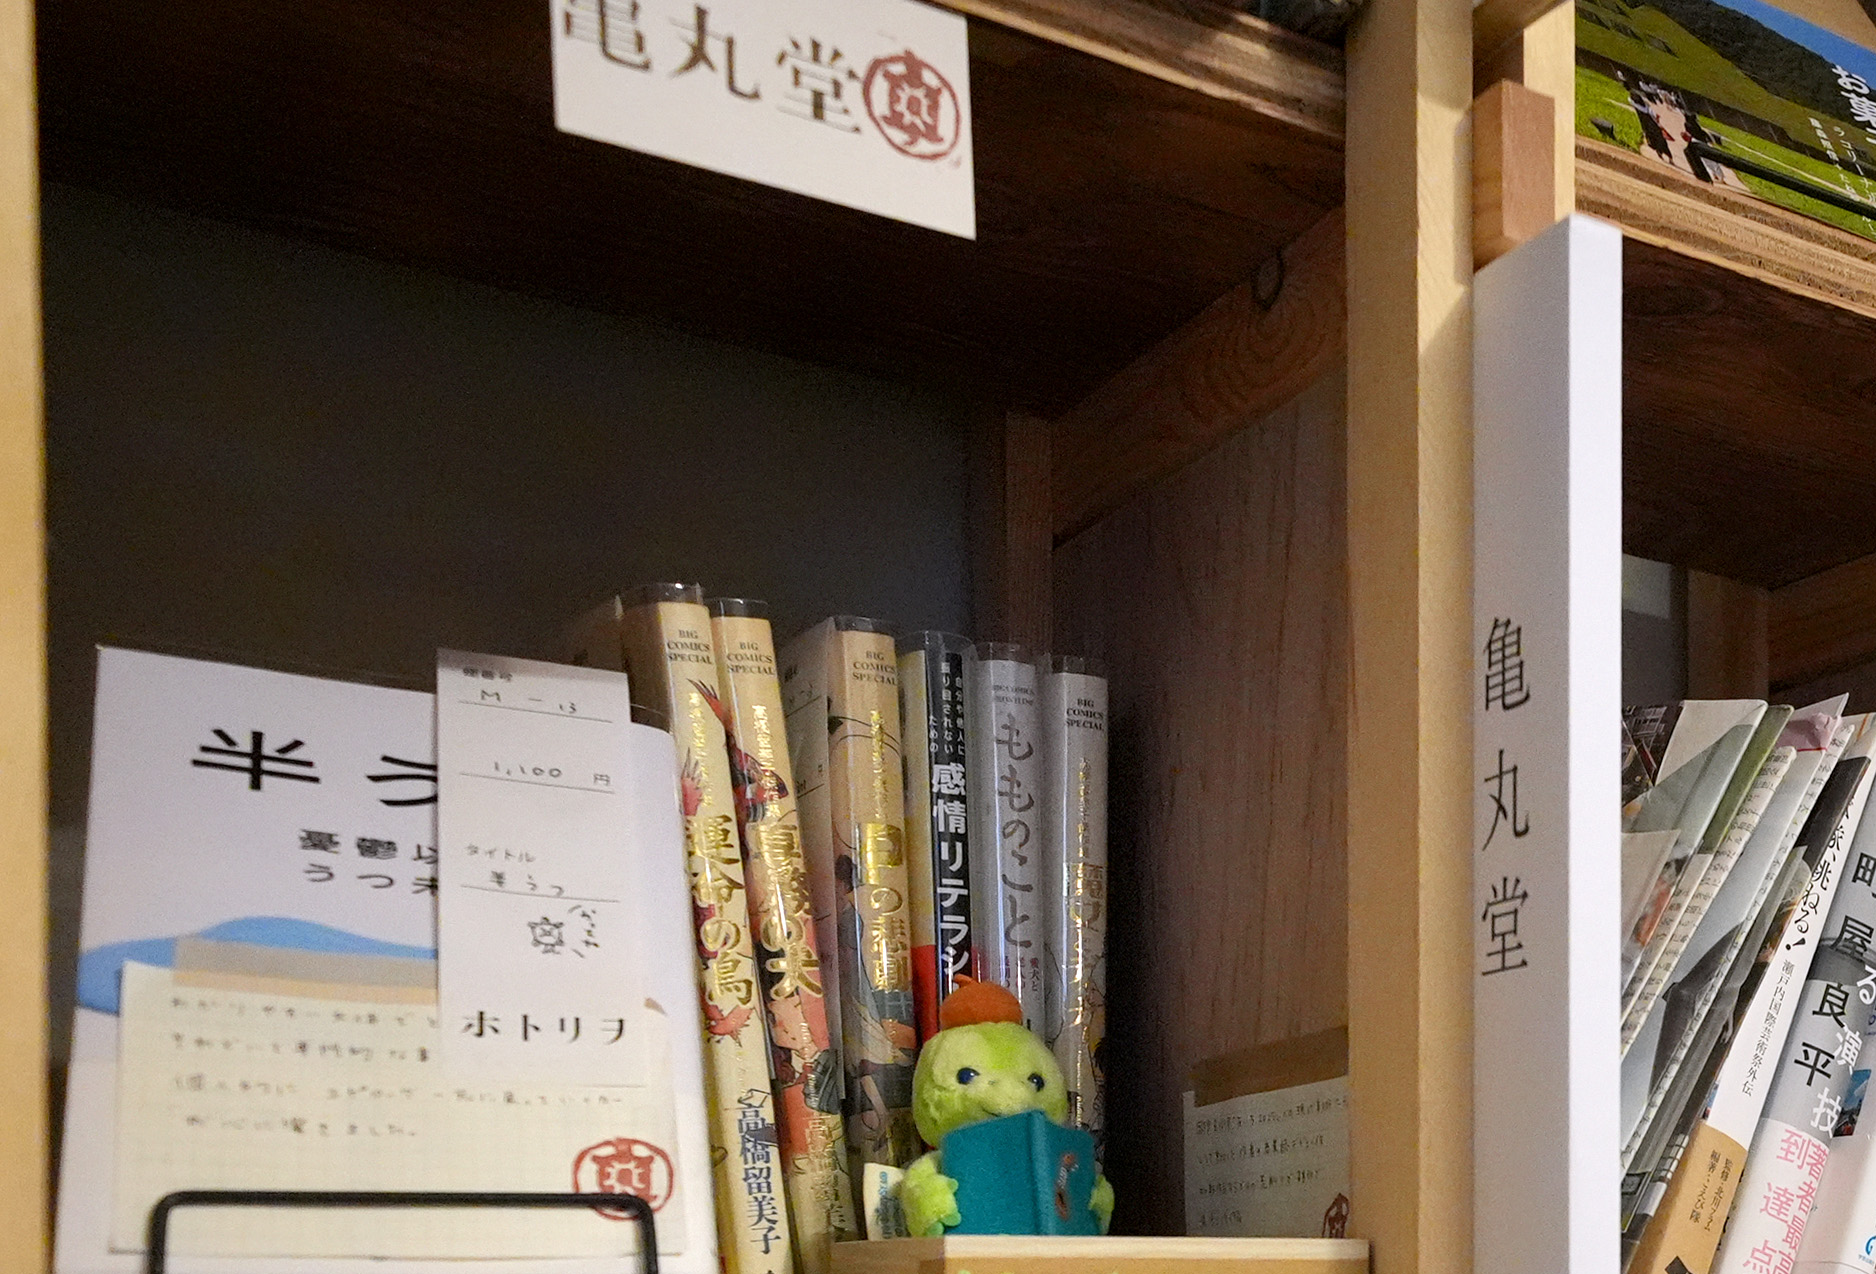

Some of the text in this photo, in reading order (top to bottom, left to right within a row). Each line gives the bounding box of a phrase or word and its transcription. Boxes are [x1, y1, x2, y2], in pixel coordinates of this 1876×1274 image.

[678, 628, 698, 640] BIG
[667, 641, 710, 654] COMICS
[740, 641, 759, 652] BIG
[667, 652, 713, 666] SPECIAL
[727, 650, 773, 665] COMICS
[865, 650, 885, 662] BIG
[726, 663, 776, 677] SPECIAL
[853, 659, 897, 673] COMICS
[851, 671, 897, 686] SPECIAL
[1076, 698, 1094, 708] BIG
[1066, 706, 1104, 720] COMICS
[1066, 717, 1105, 731] SPECIAL
[1481, 617, 1530, 976] 亀丸堂
[994, 714, 1035, 949] もものこと
[462, 1011, 627, 1044] ホトリヲ
[1742, 959, 1795, 1097] 瀬戸内国際芸術祭外伝
[738, 1103, 781, 1255] 高橋留美子
